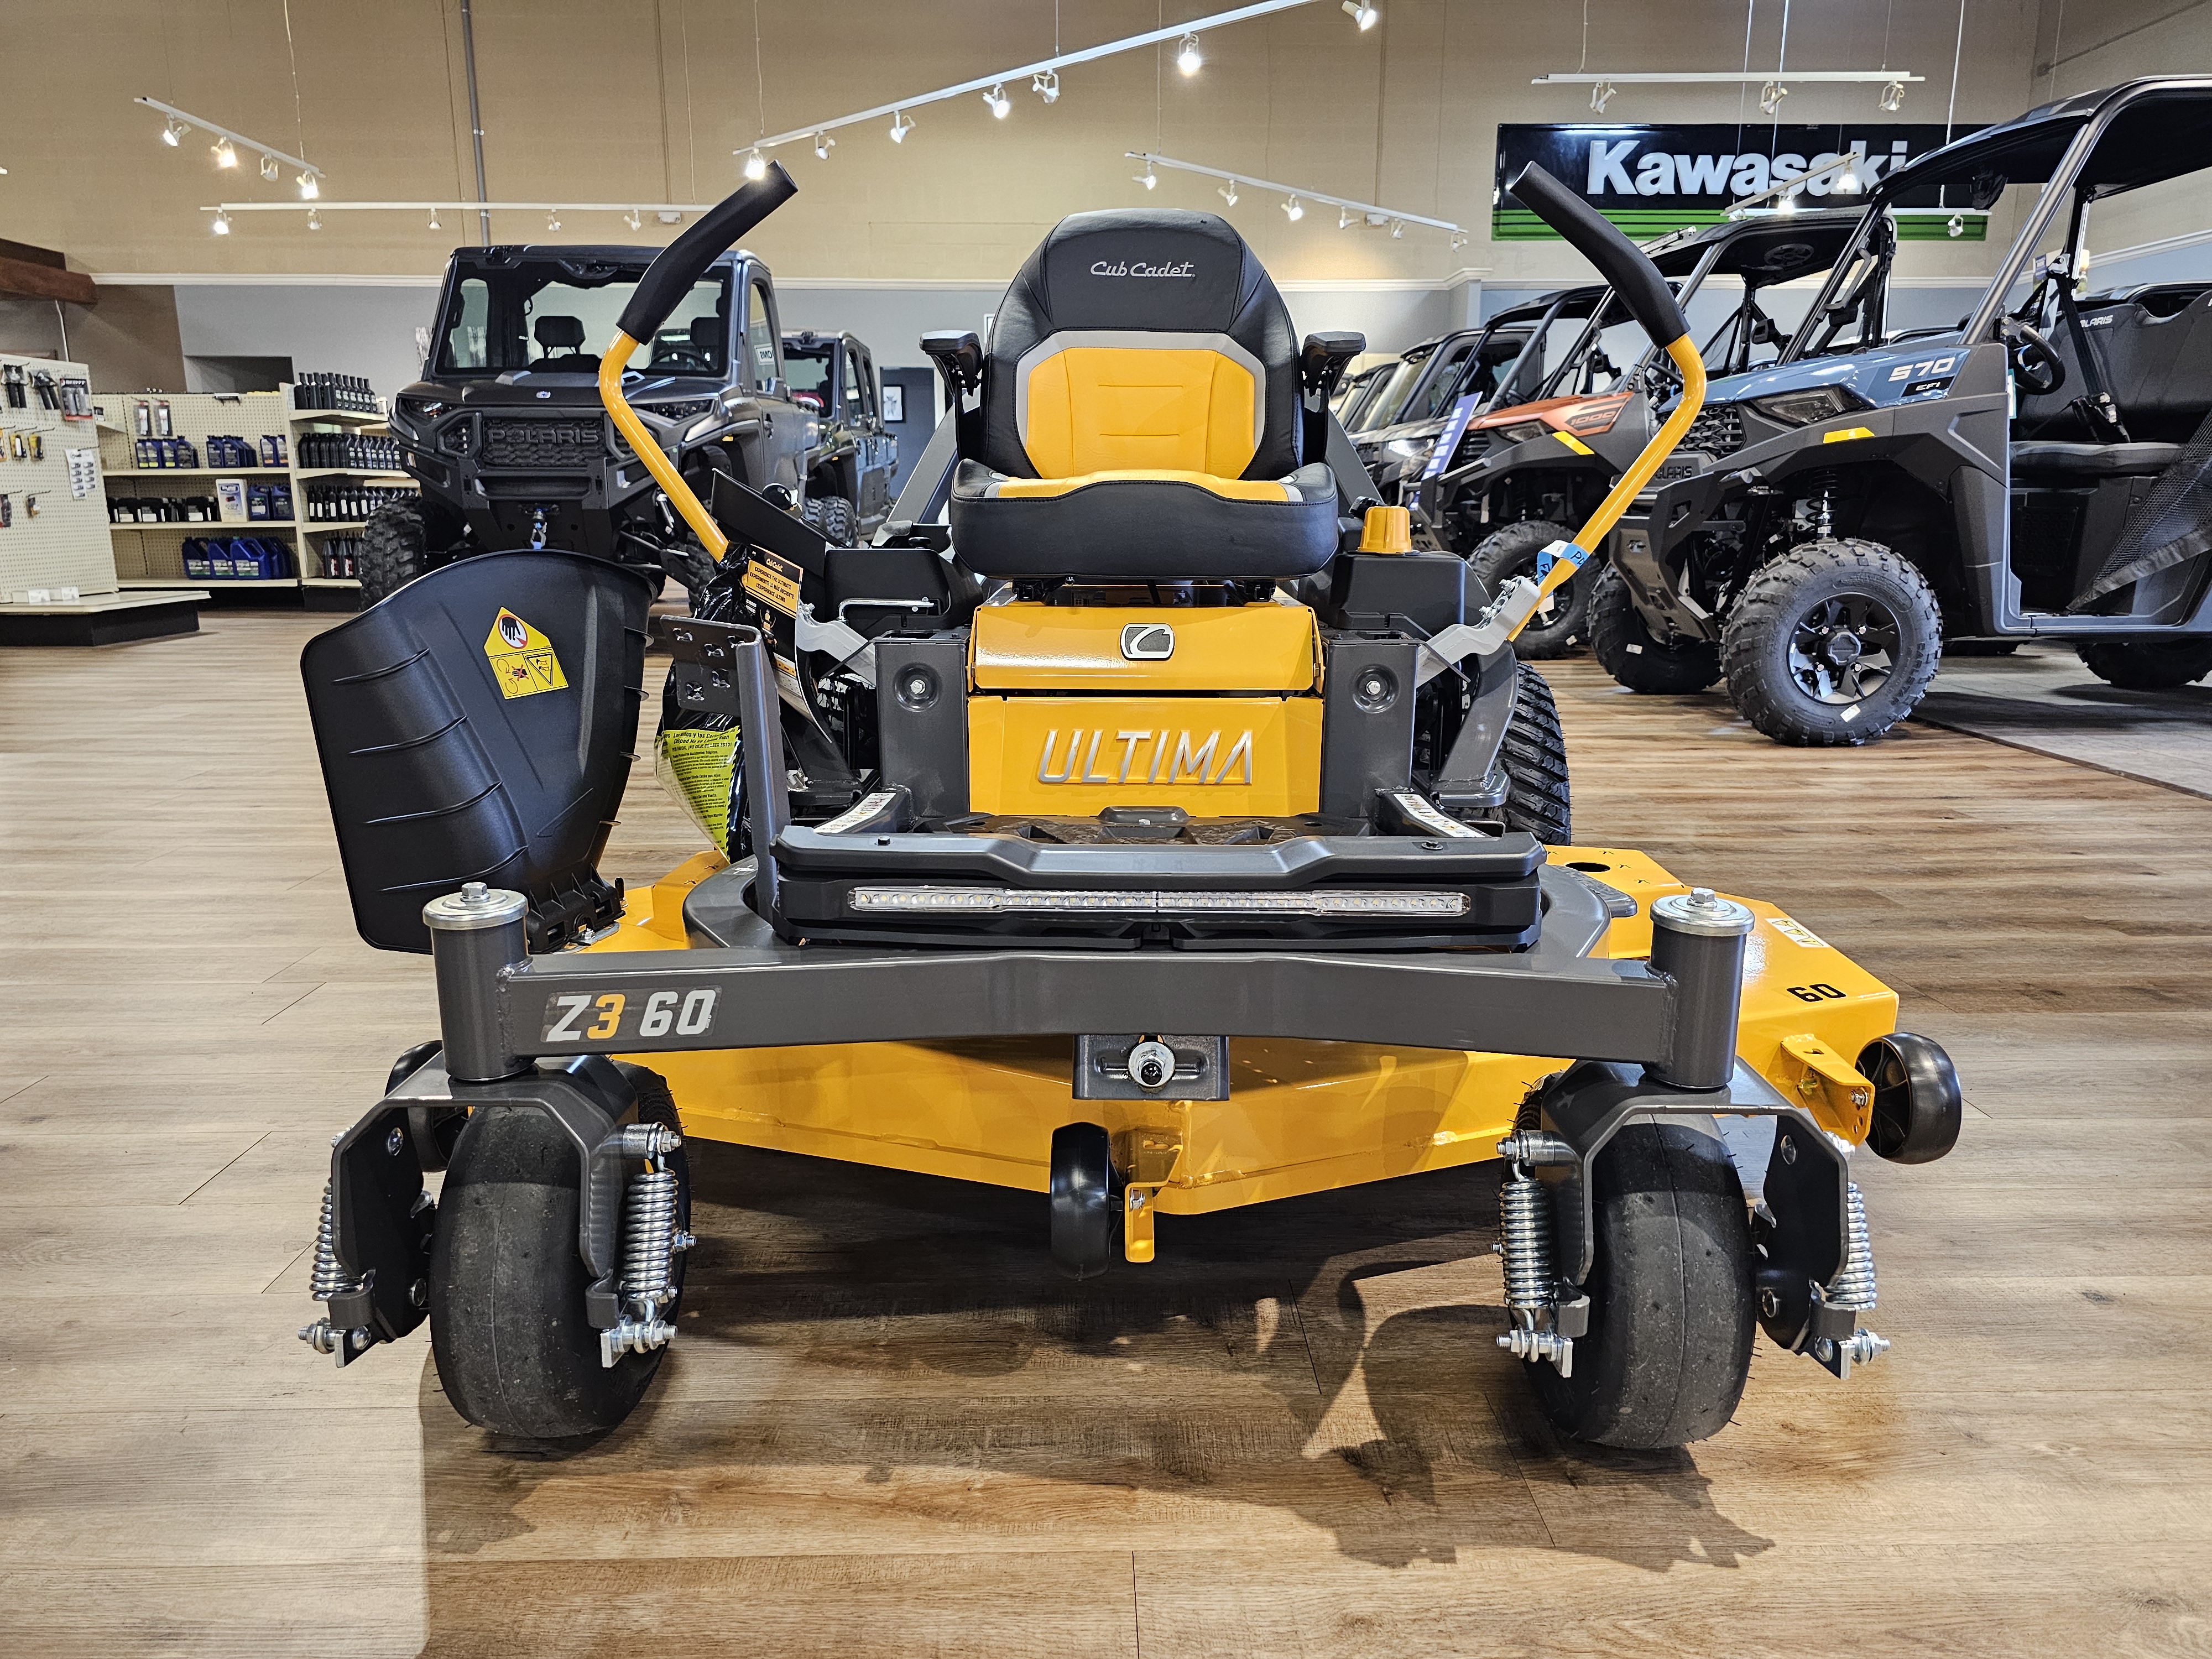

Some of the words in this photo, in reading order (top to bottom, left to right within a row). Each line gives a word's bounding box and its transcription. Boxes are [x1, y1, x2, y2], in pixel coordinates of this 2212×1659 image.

[1090, 261, 1128, 276] Cub
[1130, 262, 1194, 277] Cadet
[1888, 357, 1956, 382] 570
[1915, 382, 1940, 391] EFI
[1570, 410, 1616, 425] 1000
[487, 429, 599, 444] POLARIS
[754, 566, 772, 579] EXPERIENCE
[778, 578, 791, 590] ULTIMATE
[1038, 729, 1252, 785] ULTIMA
[1787, 983, 1846, 1002] 60
[546, 993, 626, 1042] Z3
[639, 989, 716, 1037] 60
